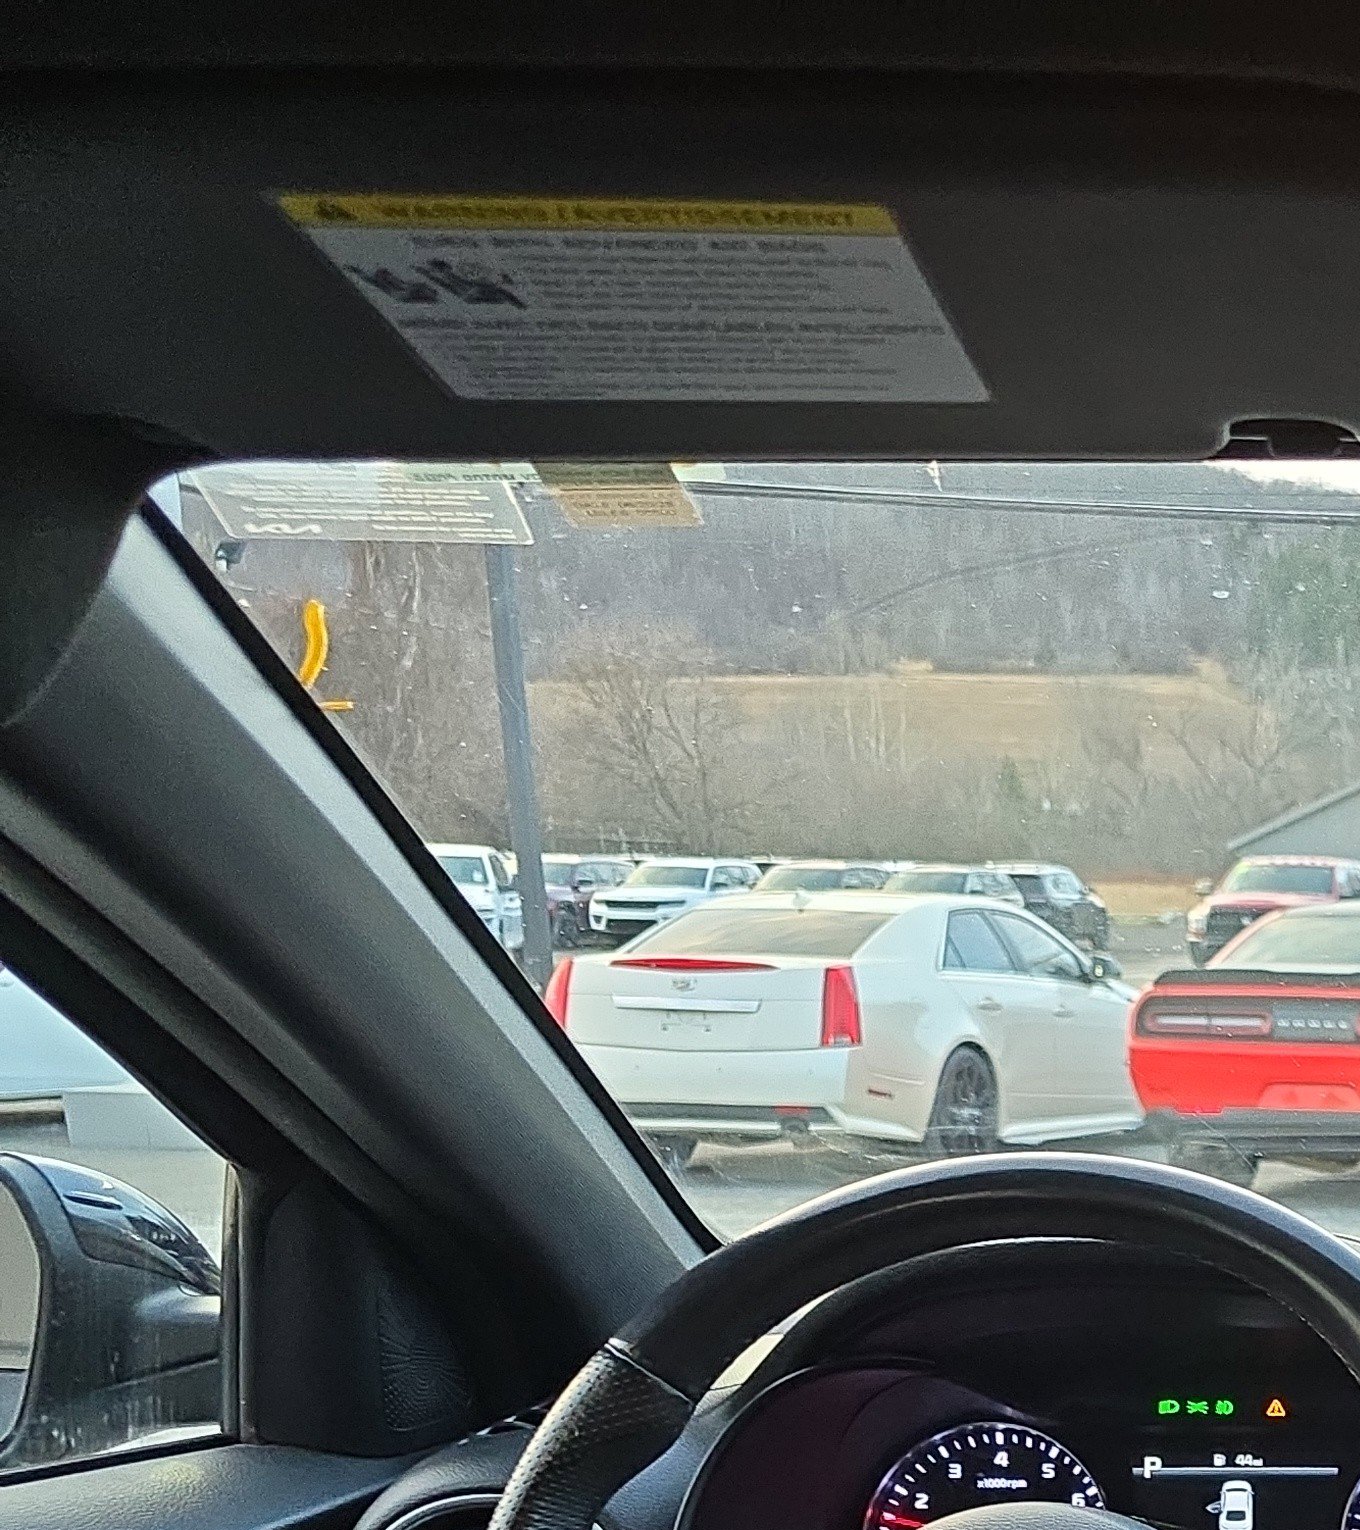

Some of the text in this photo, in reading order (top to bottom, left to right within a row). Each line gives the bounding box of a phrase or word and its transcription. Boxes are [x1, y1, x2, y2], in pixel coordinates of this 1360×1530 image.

[993, 1451, 1010, 1467] 4
[949, 1463, 962, 1478] 3
[1042, 1463, 1056, 1478] 5
[1144, 1456, 1162, 1478] P
[914, 1493, 929, 1509] 2
[1071, 1493, 1086, 1507] 6
